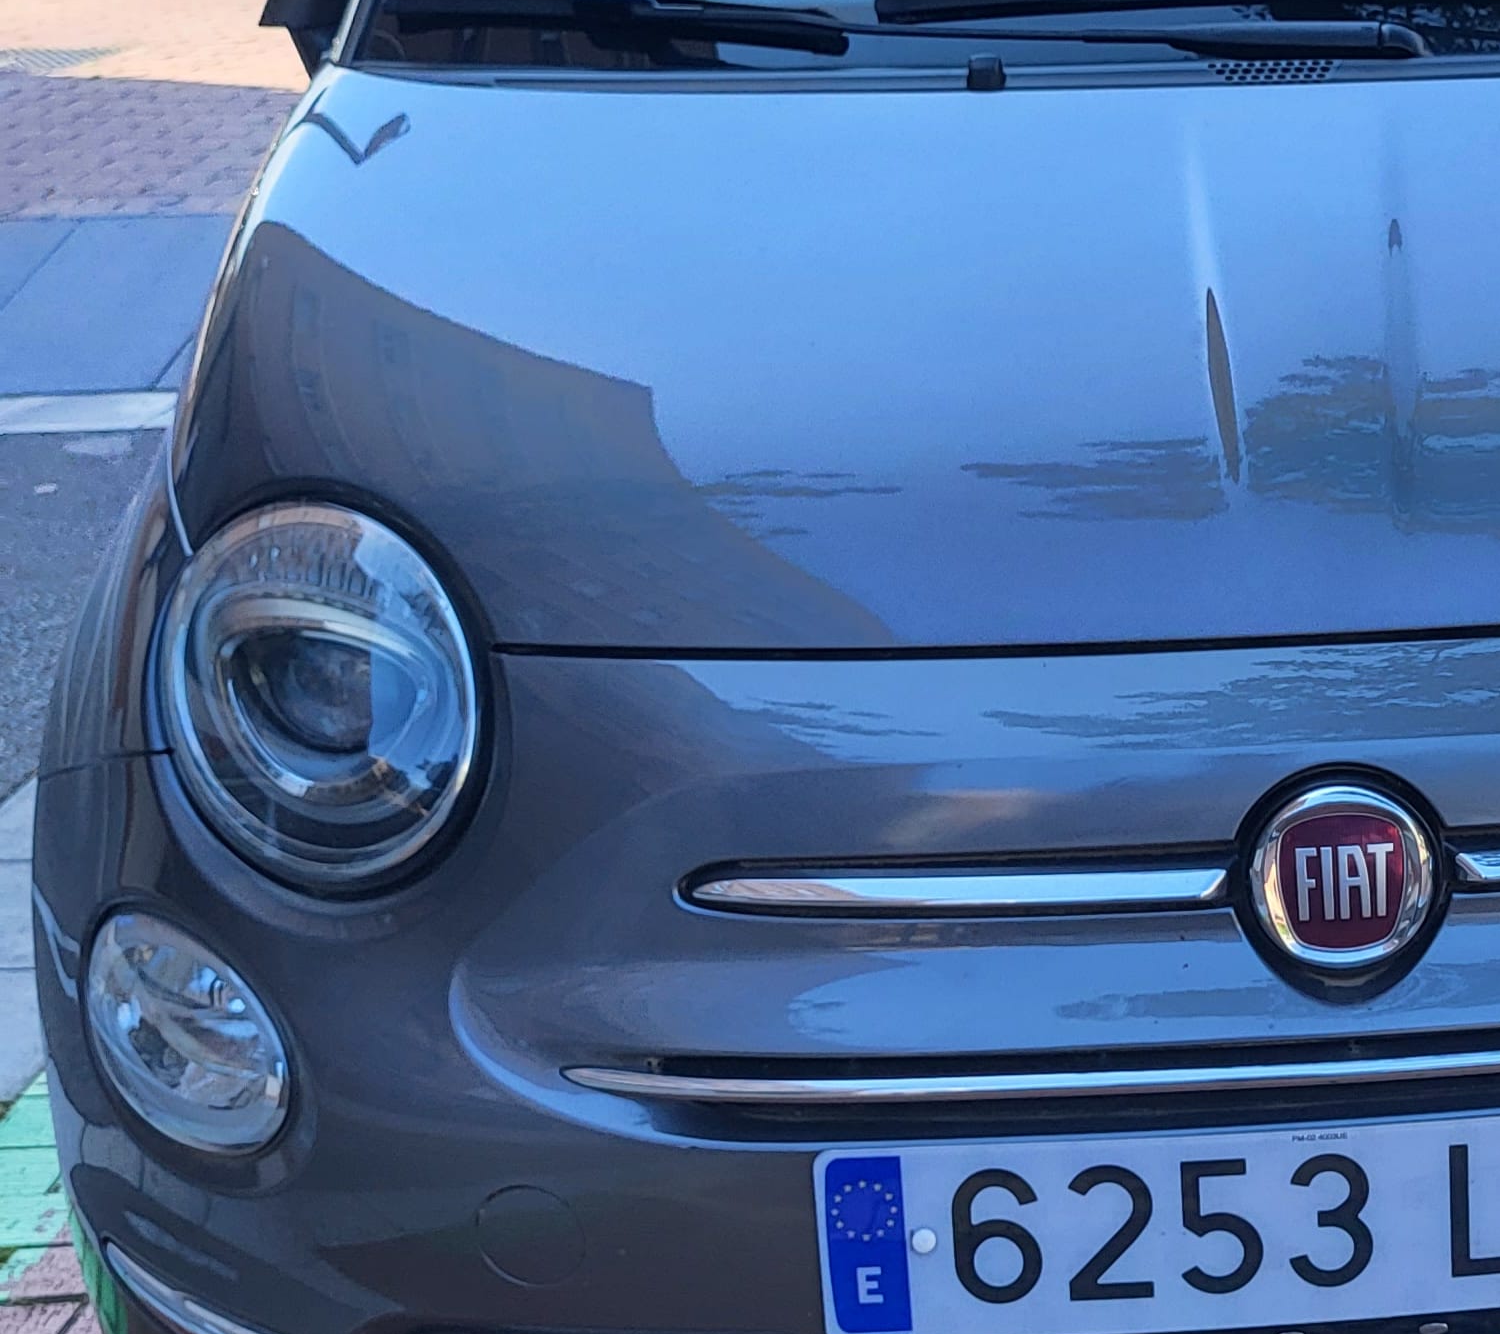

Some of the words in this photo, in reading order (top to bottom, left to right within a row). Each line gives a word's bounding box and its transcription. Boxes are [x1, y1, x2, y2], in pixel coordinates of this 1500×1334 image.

[1295, 842, 1394, 922] FIAT
[950, 1152, 1375, 1304] 6253
[856, 1266, 884, 1304] E
